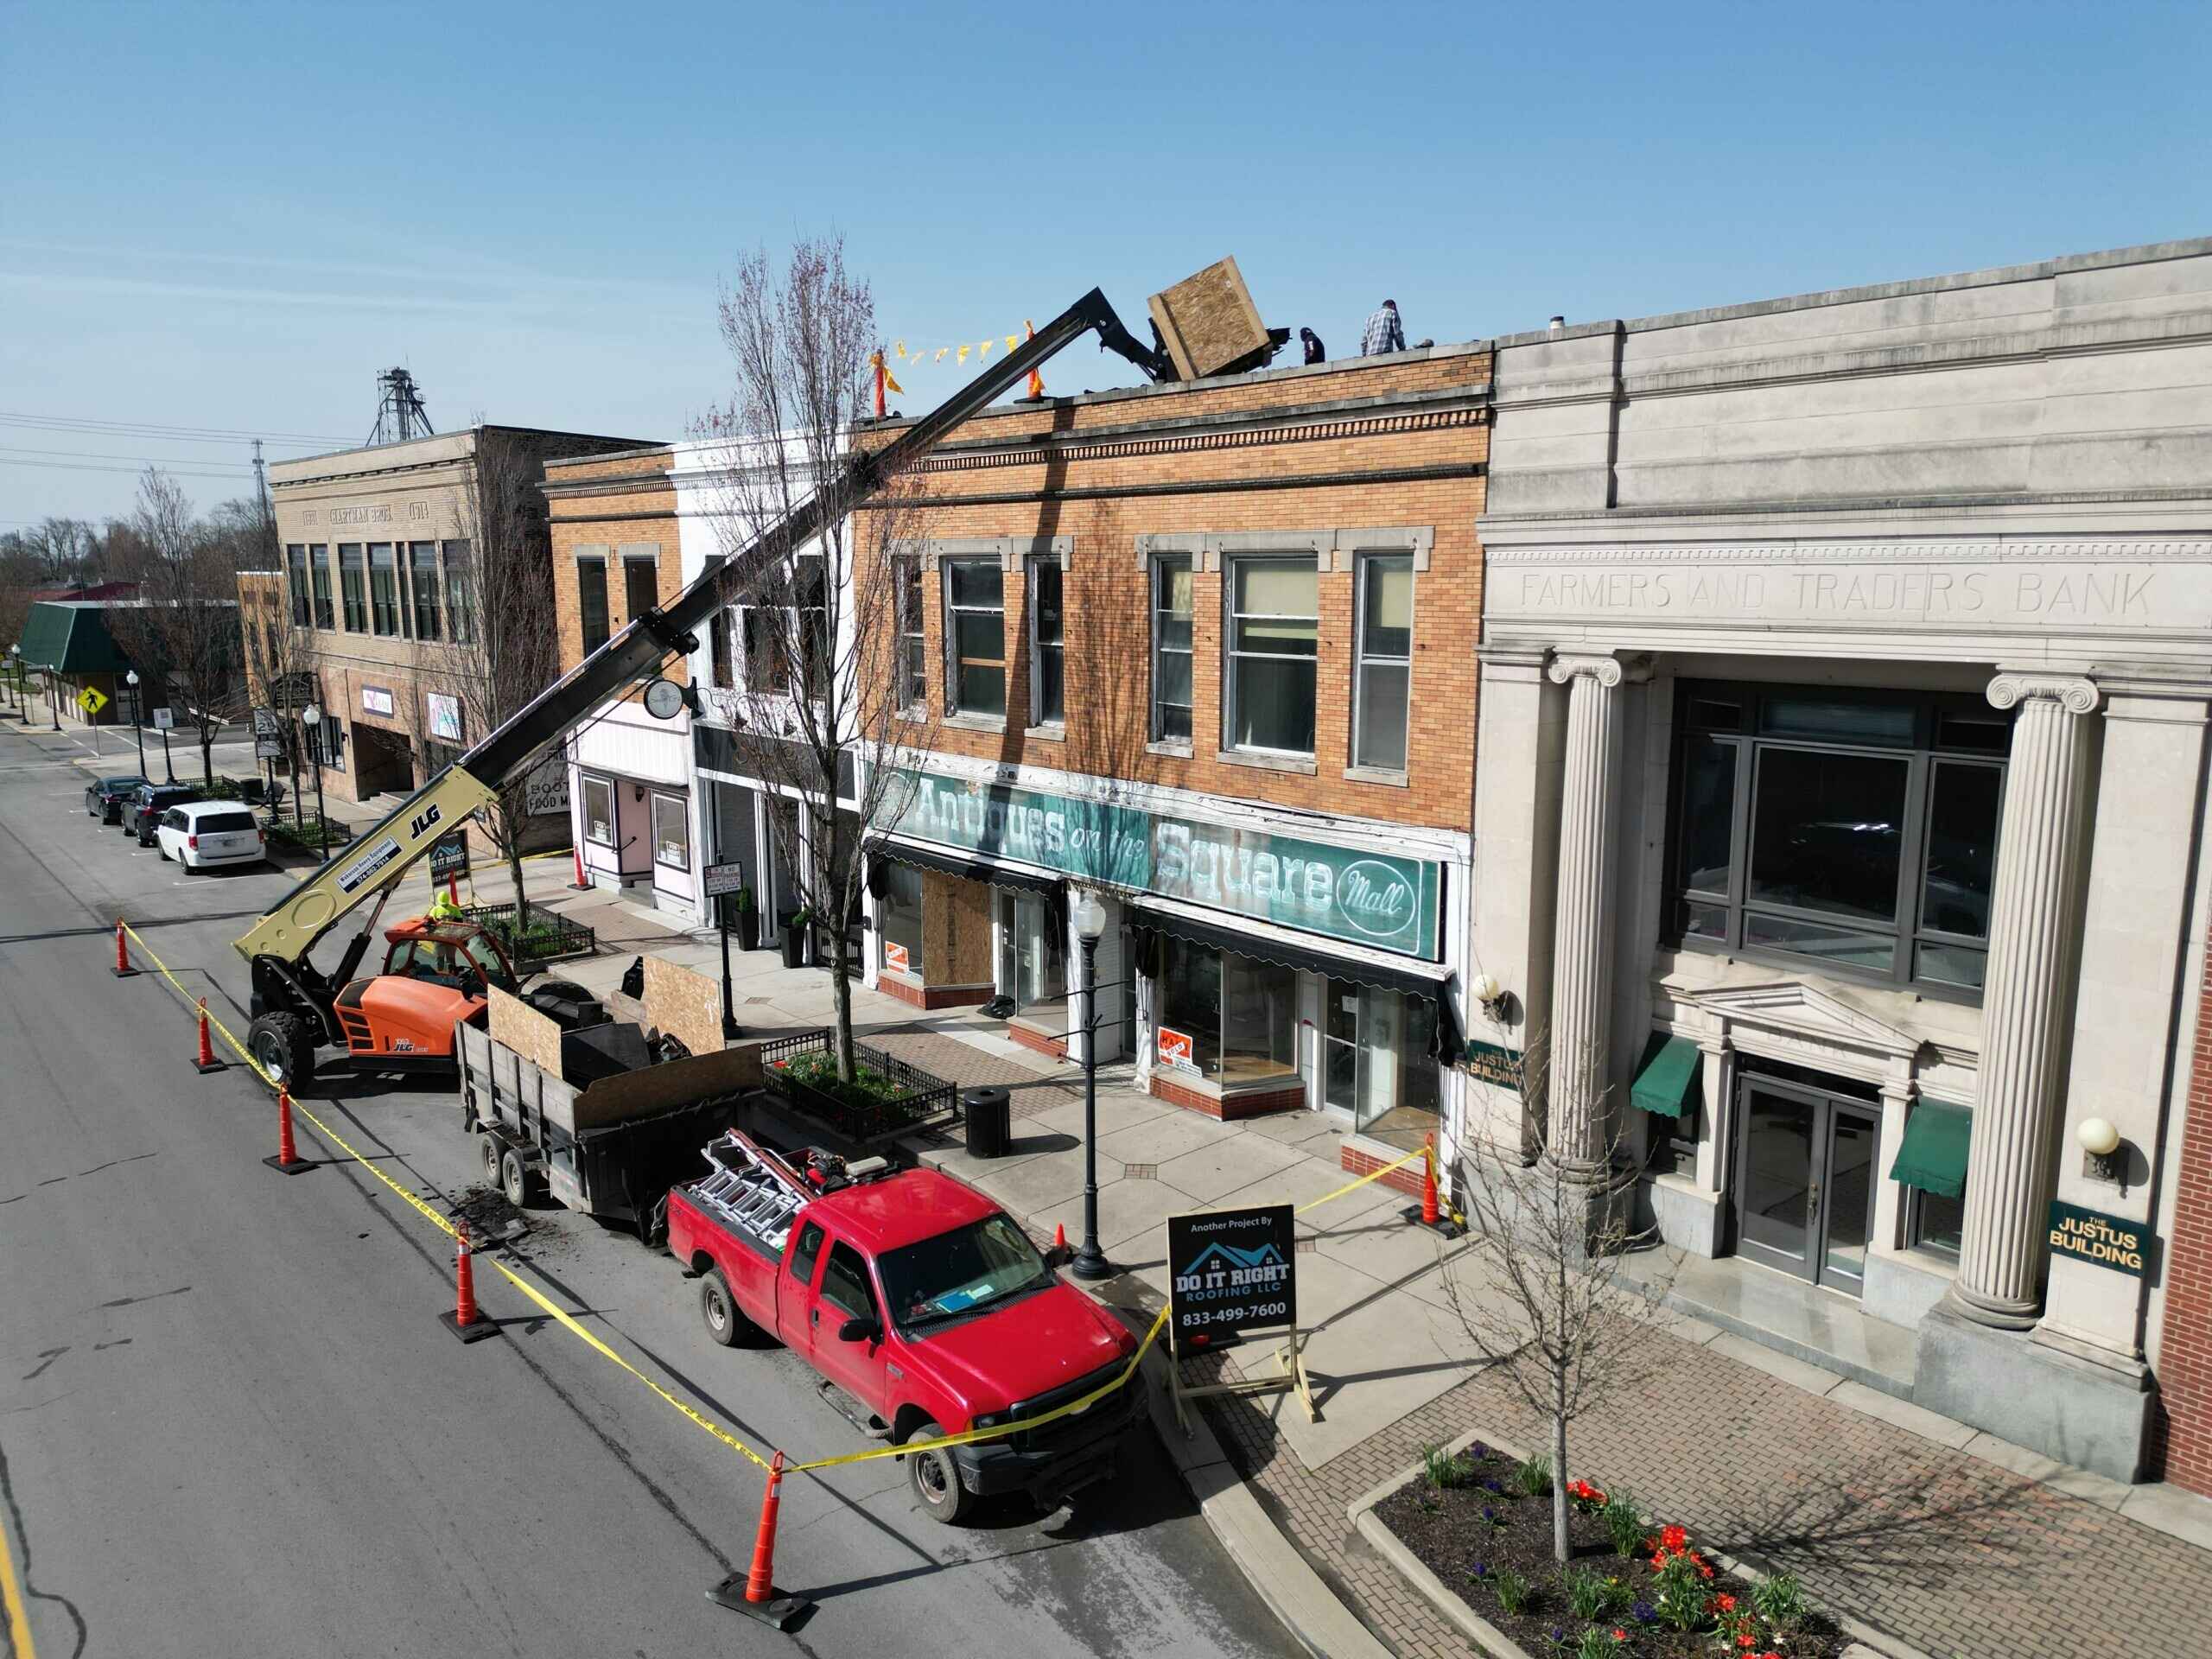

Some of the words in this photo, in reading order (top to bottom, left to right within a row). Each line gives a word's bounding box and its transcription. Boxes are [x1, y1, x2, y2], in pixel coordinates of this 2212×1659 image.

[1522, 573, 1673, 607] FARMERS
[1689, 574, 1765, 608] AND
[1792, 573, 1989, 611] TRADERS
[2016, 573, 2156, 614] BANK
[529, 797, 556, 809] FOOD
[410, 804, 441, 840] JLG
[916, 778, 1065, 855] Antiques
[1071, 827, 1103, 851] on
[1110, 829, 1147, 859] the
[1157, 822, 1334, 911] Square
[1344, 870, 1406, 916] Mall
[394, 1043, 414, 1052] JLG
[1191, 1221, 1227, 1232] Another
[1229, 1218, 1260, 1229] Project
[1262, 1216, 1273, 1225] By
[2058, 1217, 2138, 1250] JUSTUS
[2088, 1216, 2107, 1227] THE
[2050, 1230, 2143, 1269] BUILDING
[1176, 1274, 1201, 1293] DO
[1205, 1271, 1226, 1289] IT
[1230, 1263, 1290, 1286] RIGHT
[1186, 1286, 1252, 1302] ROOFING
[1257, 1282, 1281, 1294] LLC
[1182, 1302, 1287, 1326] 833-499-7600
